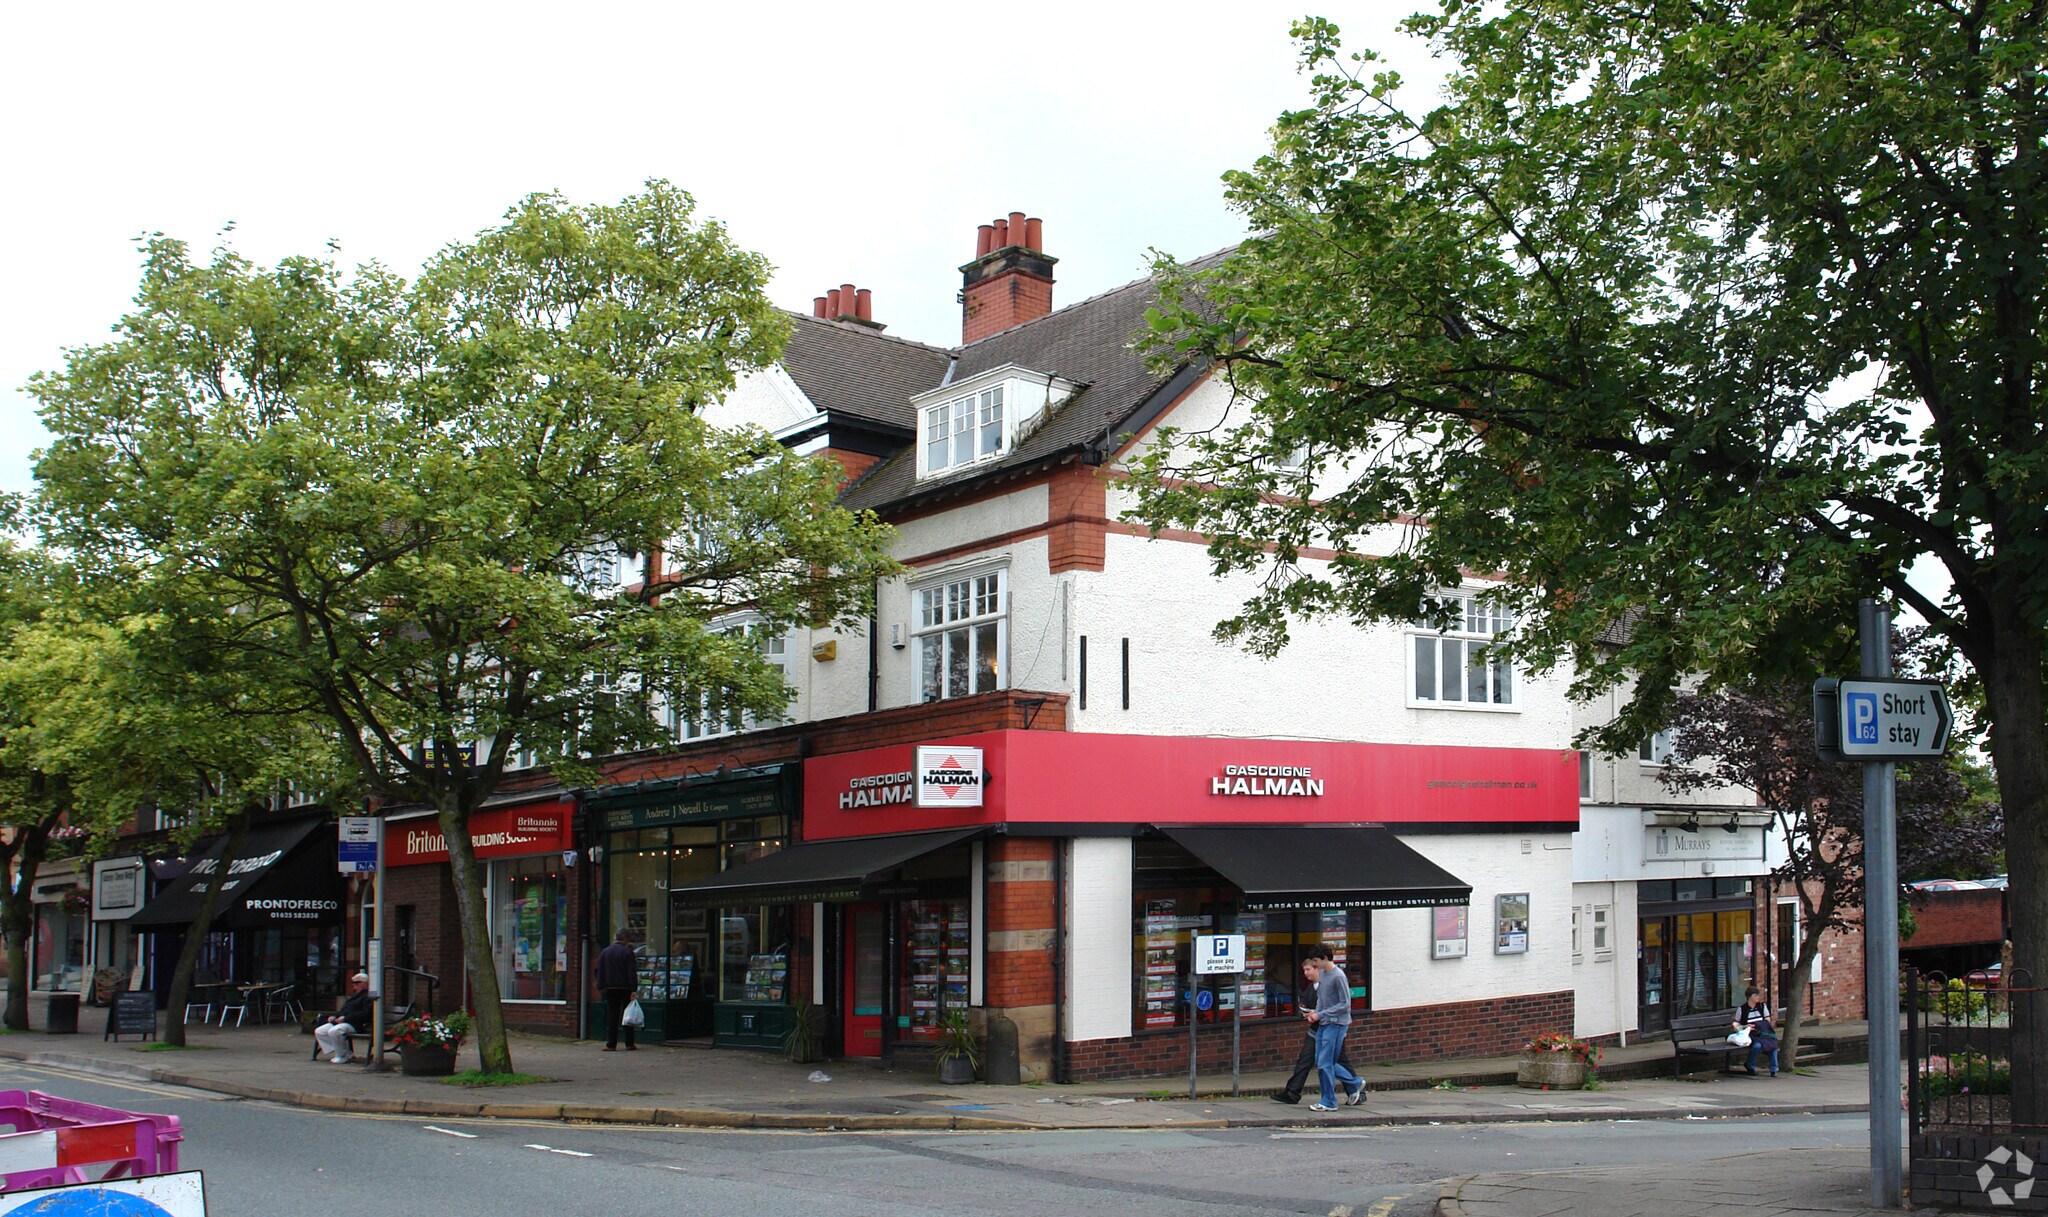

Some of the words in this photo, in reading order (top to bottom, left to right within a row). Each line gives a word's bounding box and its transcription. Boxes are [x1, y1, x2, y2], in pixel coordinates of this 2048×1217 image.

[1883, 693, 1926, 715] Short
[1855, 699, 1874, 739] P
[1863, 726, 1876, 739] 62
[1889, 722, 1920, 747] stay
[1226, 764, 1312, 777] GASCOIGNE
[850, 771, 913, 789] GASCOIGN
[923, 775, 979, 785] HALMAN
[1212, 777, 1325, 796] HALMAN
[839, 784, 913, 810] HALMA
[517, 816, 558, 826] Britannia
[407, 830, 449, 855] Britan
[472, 832, 505, 847] BUILDING
[246, 899, 338, 910] PRONTOFRESCO
[270, 911, 293, 919] 01625
[1216, 939, 1227, 955] P
